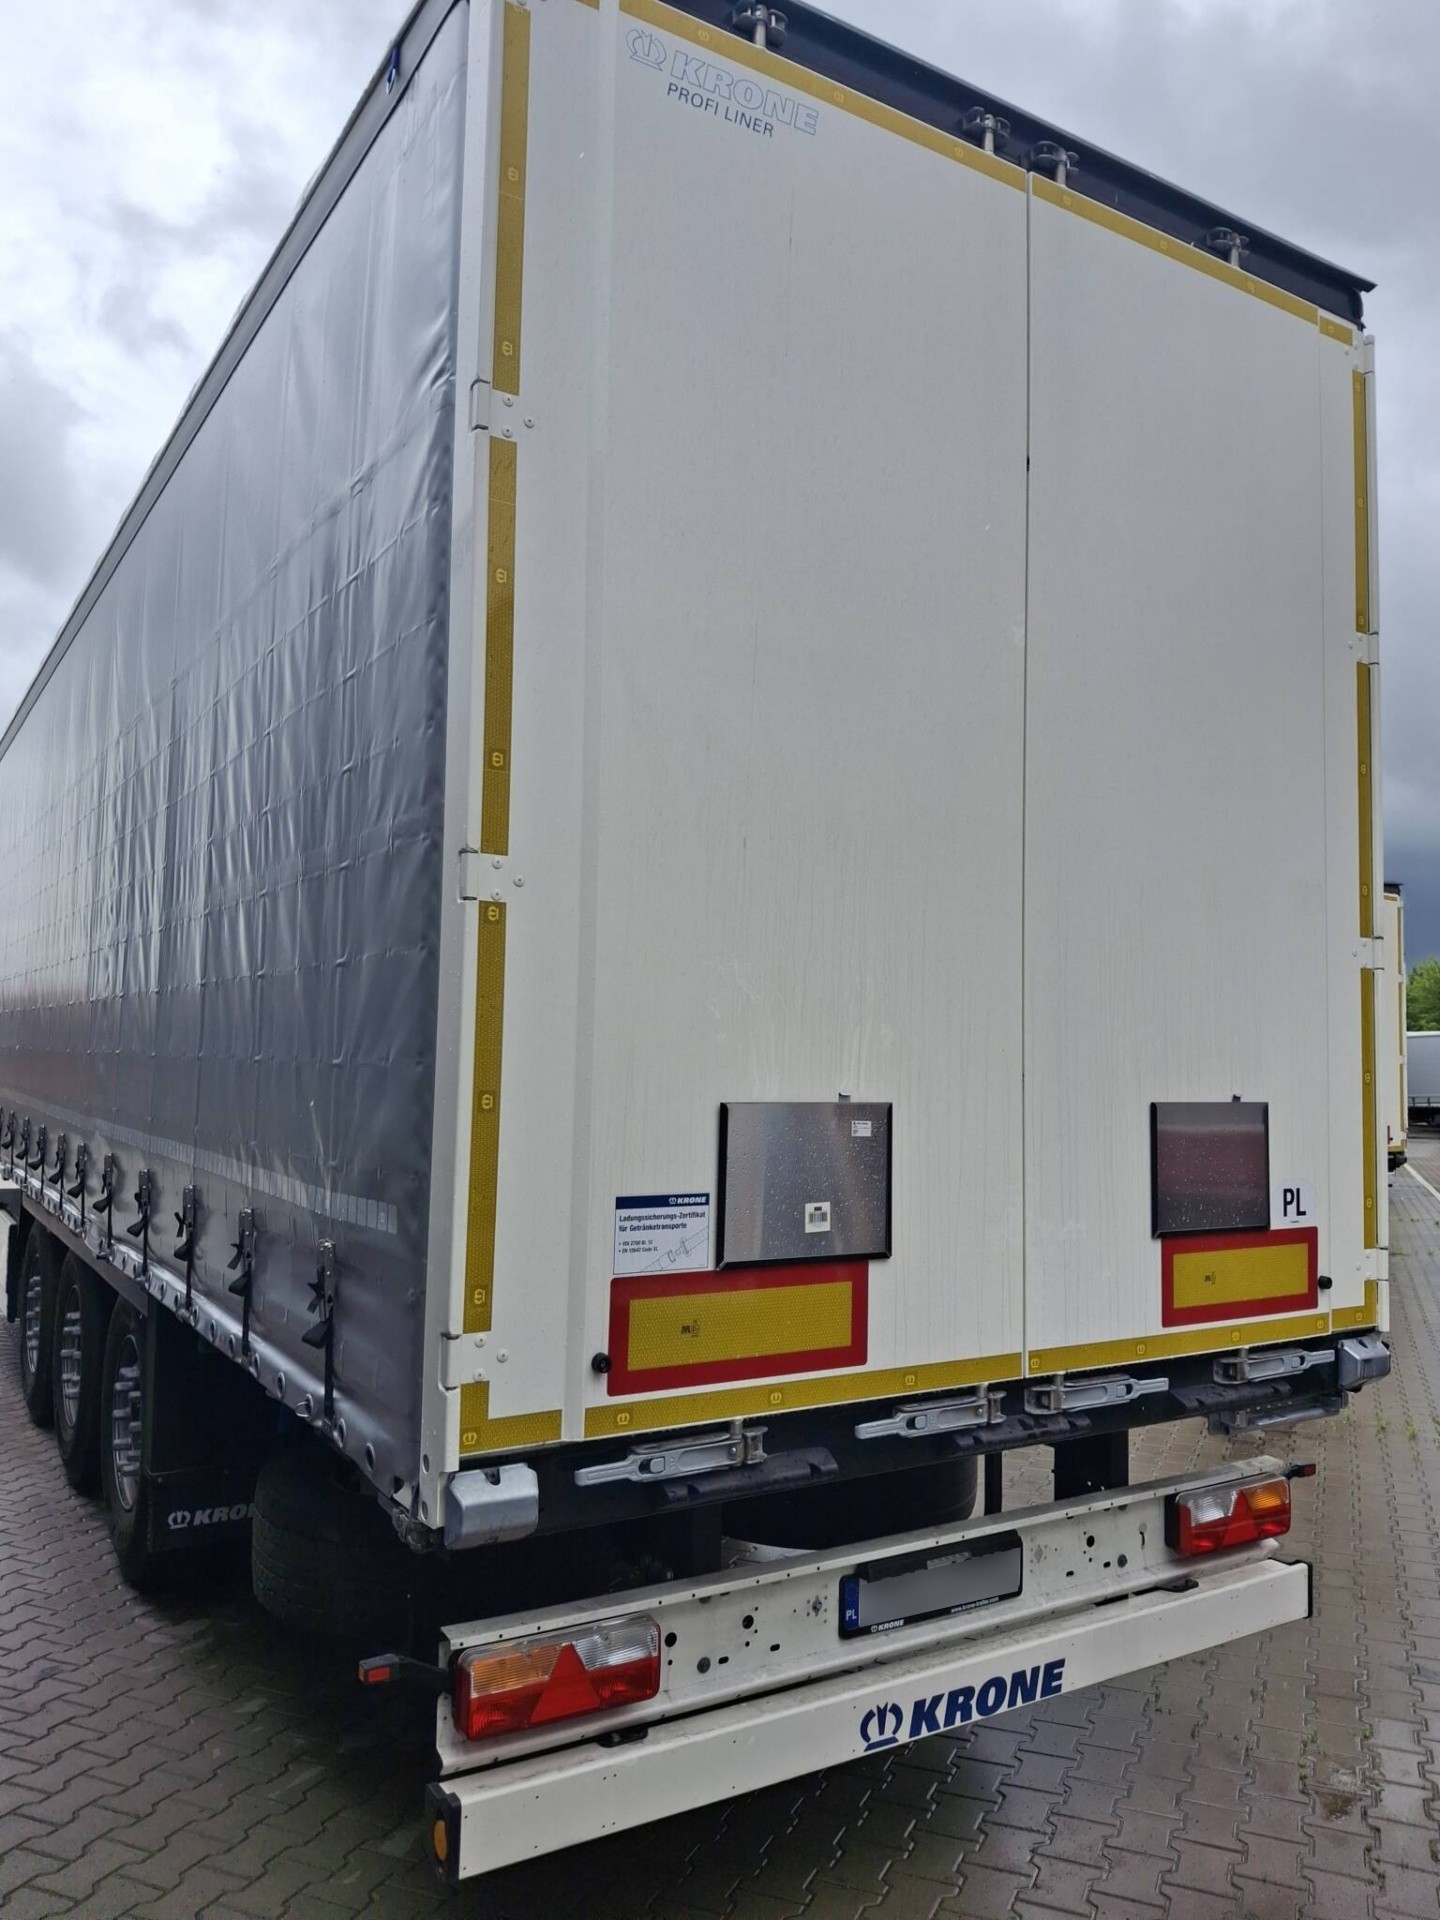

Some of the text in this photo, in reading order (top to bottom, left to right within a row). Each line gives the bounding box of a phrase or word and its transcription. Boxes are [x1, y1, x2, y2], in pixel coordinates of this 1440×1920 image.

[671, 50, 818, 136] KRONE
[667, 82, 774, 138] PROFI LINER
[677, 1196, 707, 1204] KRONE
[1283, 1187, 1306, 1217] PL
[619, 1211, 705, 1222] Ladungssicherungs-Zertifikat
[619, 1222, 687, 1232] für Getränketransporte
[845, 1609, 857, 1621] PL
[878, 1619, 905, 1631] KRONE
[909, 1657, 1066, 1739] KRONE
